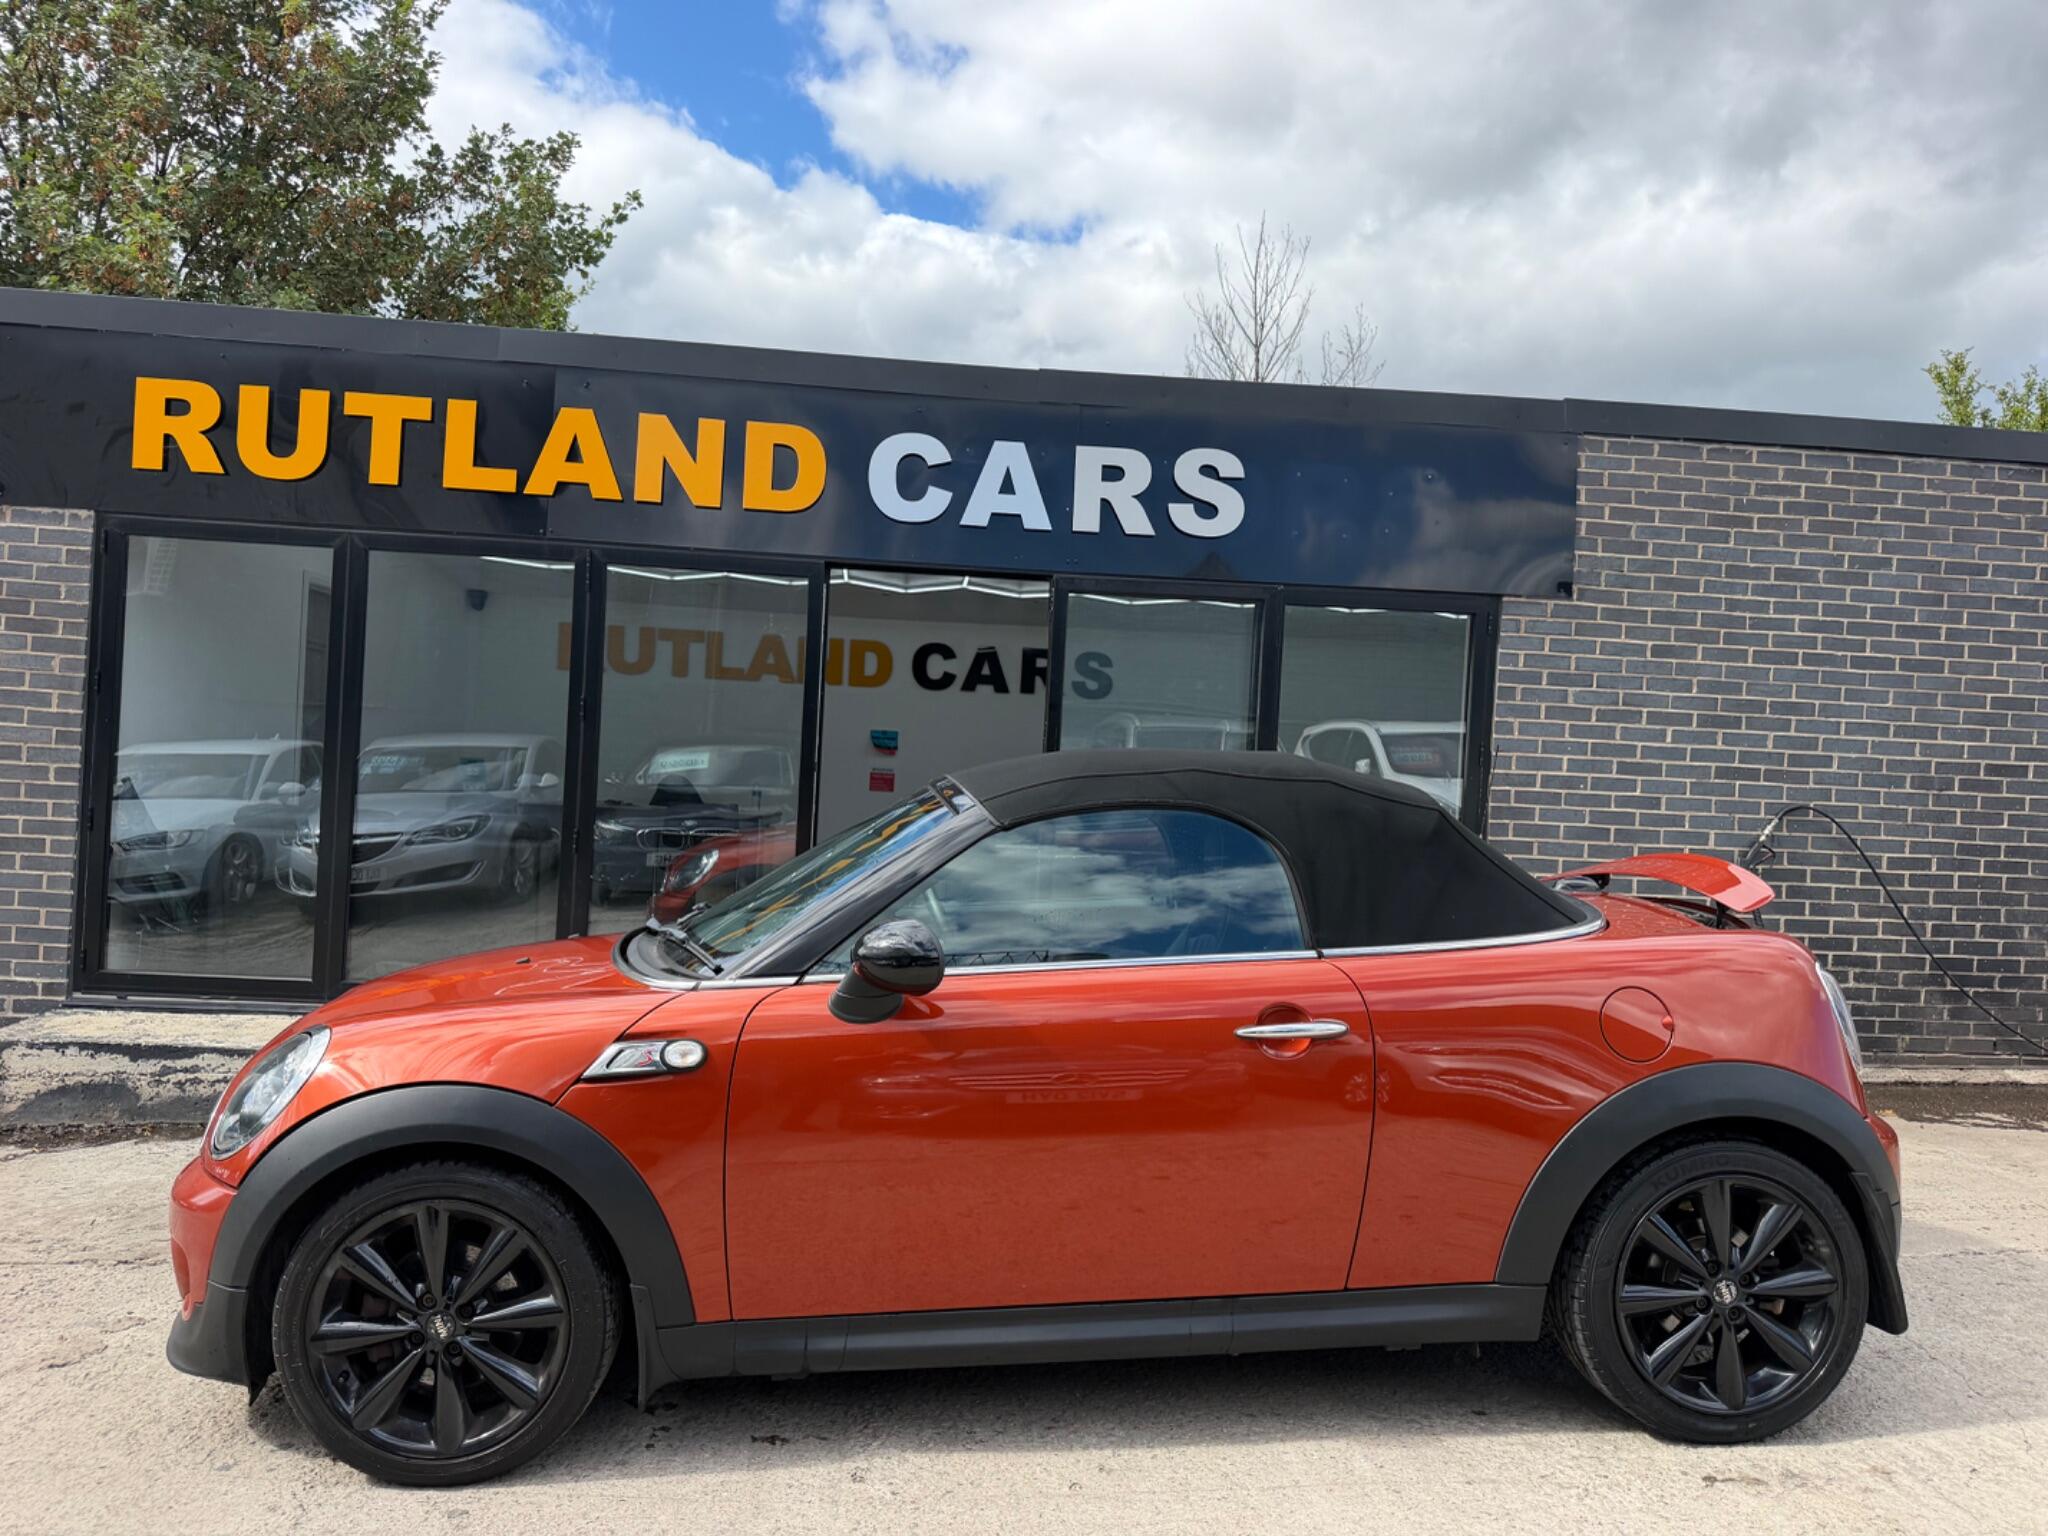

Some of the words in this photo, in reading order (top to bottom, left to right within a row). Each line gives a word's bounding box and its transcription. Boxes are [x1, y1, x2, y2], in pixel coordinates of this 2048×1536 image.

[131, 376, 827, 512] RUTLAND
[867, 431, 1247, 539] CARS
[556, 622, 894, 689] UTLAND
[911, 642, 1115, 701] CARS
